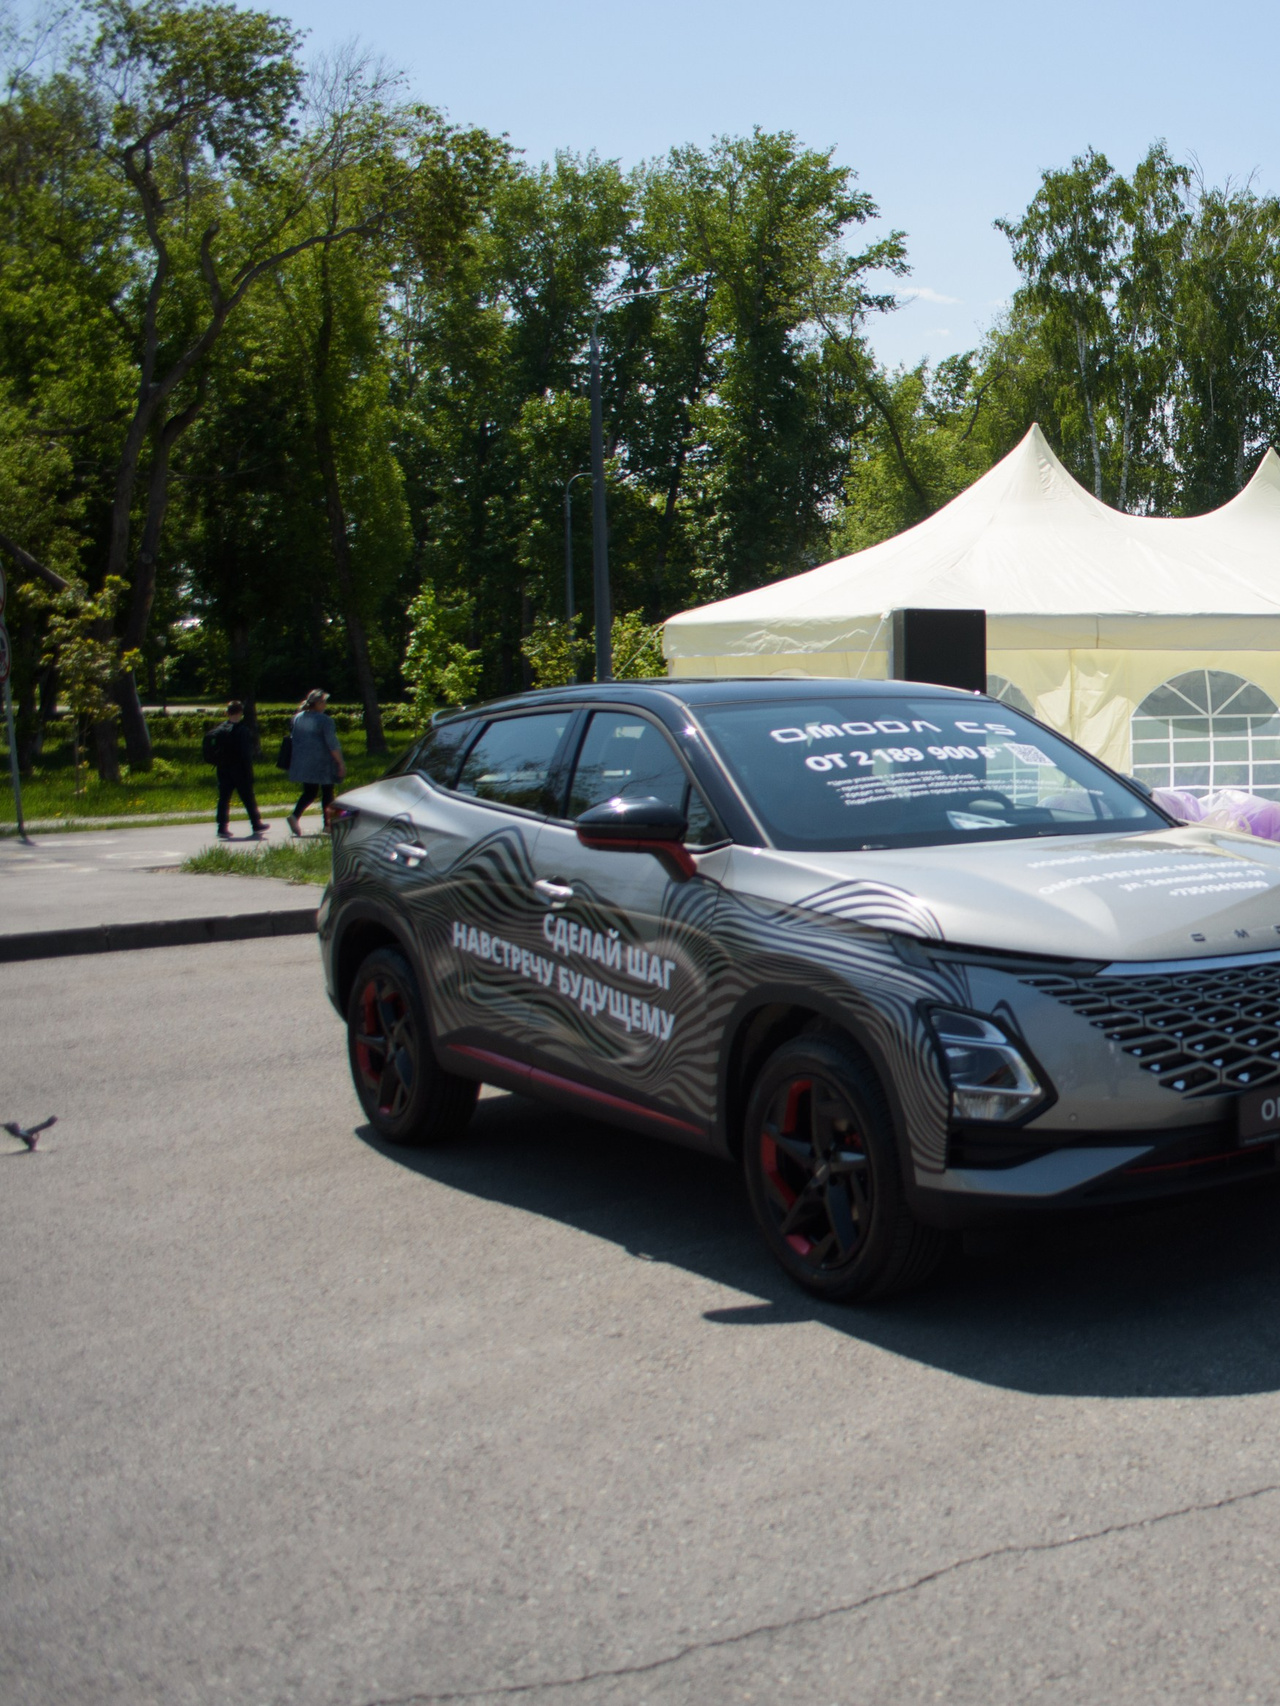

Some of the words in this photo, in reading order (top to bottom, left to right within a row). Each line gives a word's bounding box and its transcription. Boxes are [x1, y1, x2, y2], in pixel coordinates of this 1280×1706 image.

[770, 721, 942, 743] OMODA
[805, 753, 848, 771] ОТ
[927, 745, 979, 760] 900
[543, 913, 622, 971] СДЕЛАЙ
[627, 945, 676, 990] ШАГ
[453, 921, 554, 986] НАВСТРЕЧУ
[558, 966, 675, 1041] БУДУЩЕМУ
